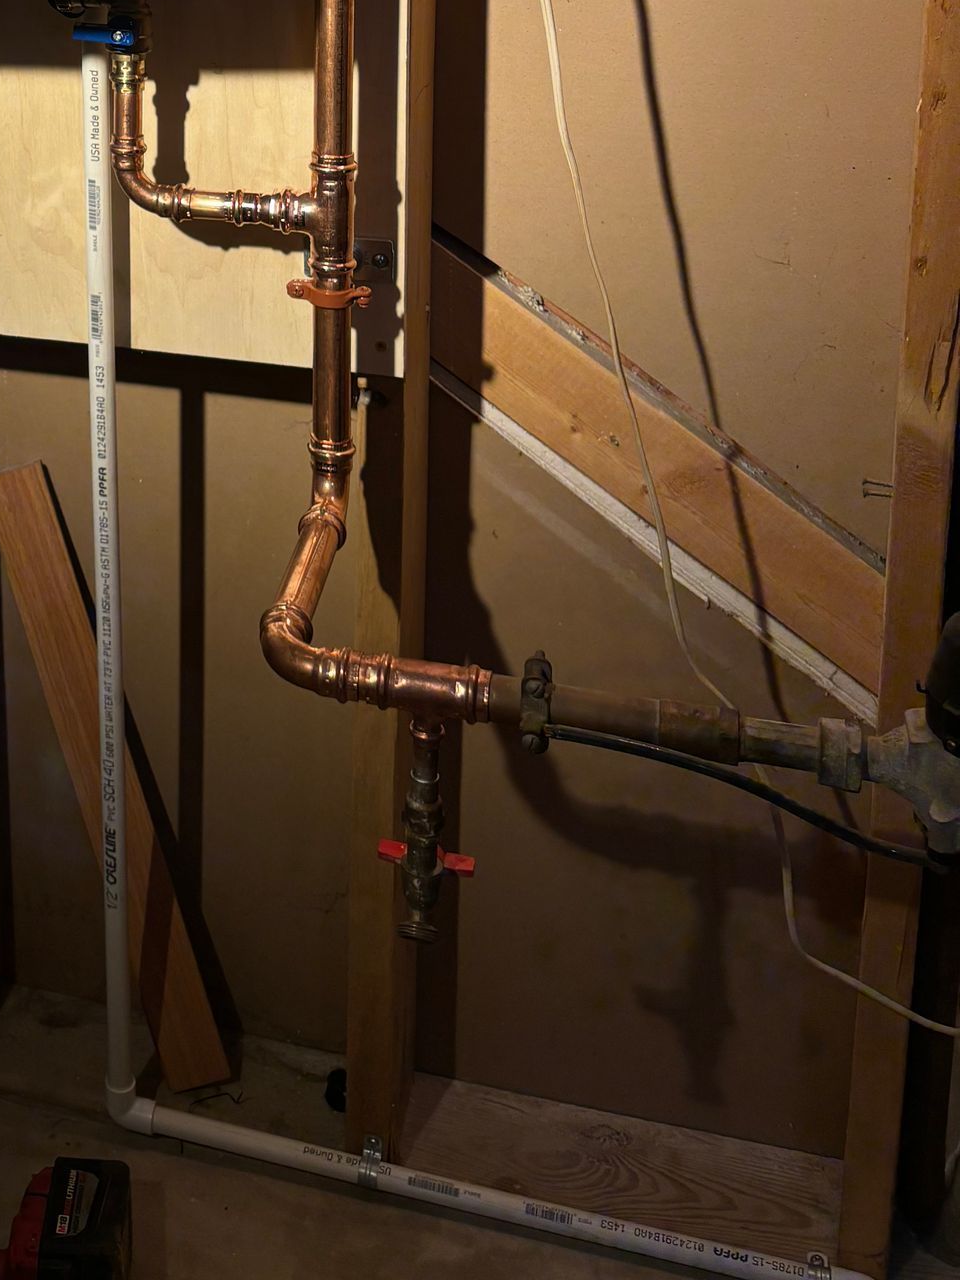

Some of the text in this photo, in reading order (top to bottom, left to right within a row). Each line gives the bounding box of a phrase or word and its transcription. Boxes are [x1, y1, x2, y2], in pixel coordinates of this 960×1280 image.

[89, 70, 99, 102] Owned
[90, 115, 100, 140] Made
[90, 144, 100, 162] USA
[95, 365, 105, 390] 1453
[98, 466, 108, 498] PPFA
[98, 500, 109, 544] D1785-15
[99, 547, 110, 570] ASTM
[102, 616, 111, 638] 1120
[102, 640, 112, 657] PVC
[103, 680, 112, 693] AT
[104, 694, 113, 722] WATER
[104, 724, 113, 740] PSI
[102, 759, 114, 777] 40
[103, 778, 115, 802] SCH
[105, 826, 117, 886] CRESLINE
[302, 1145, 334, 1161] Owned
[337, 1154, 343, 1163] &
[600, 1219, 625, 1233] 1453
[712, 1247, 749, 1263] PPFA
[752, 1256, 805, 1277] D1785-15
